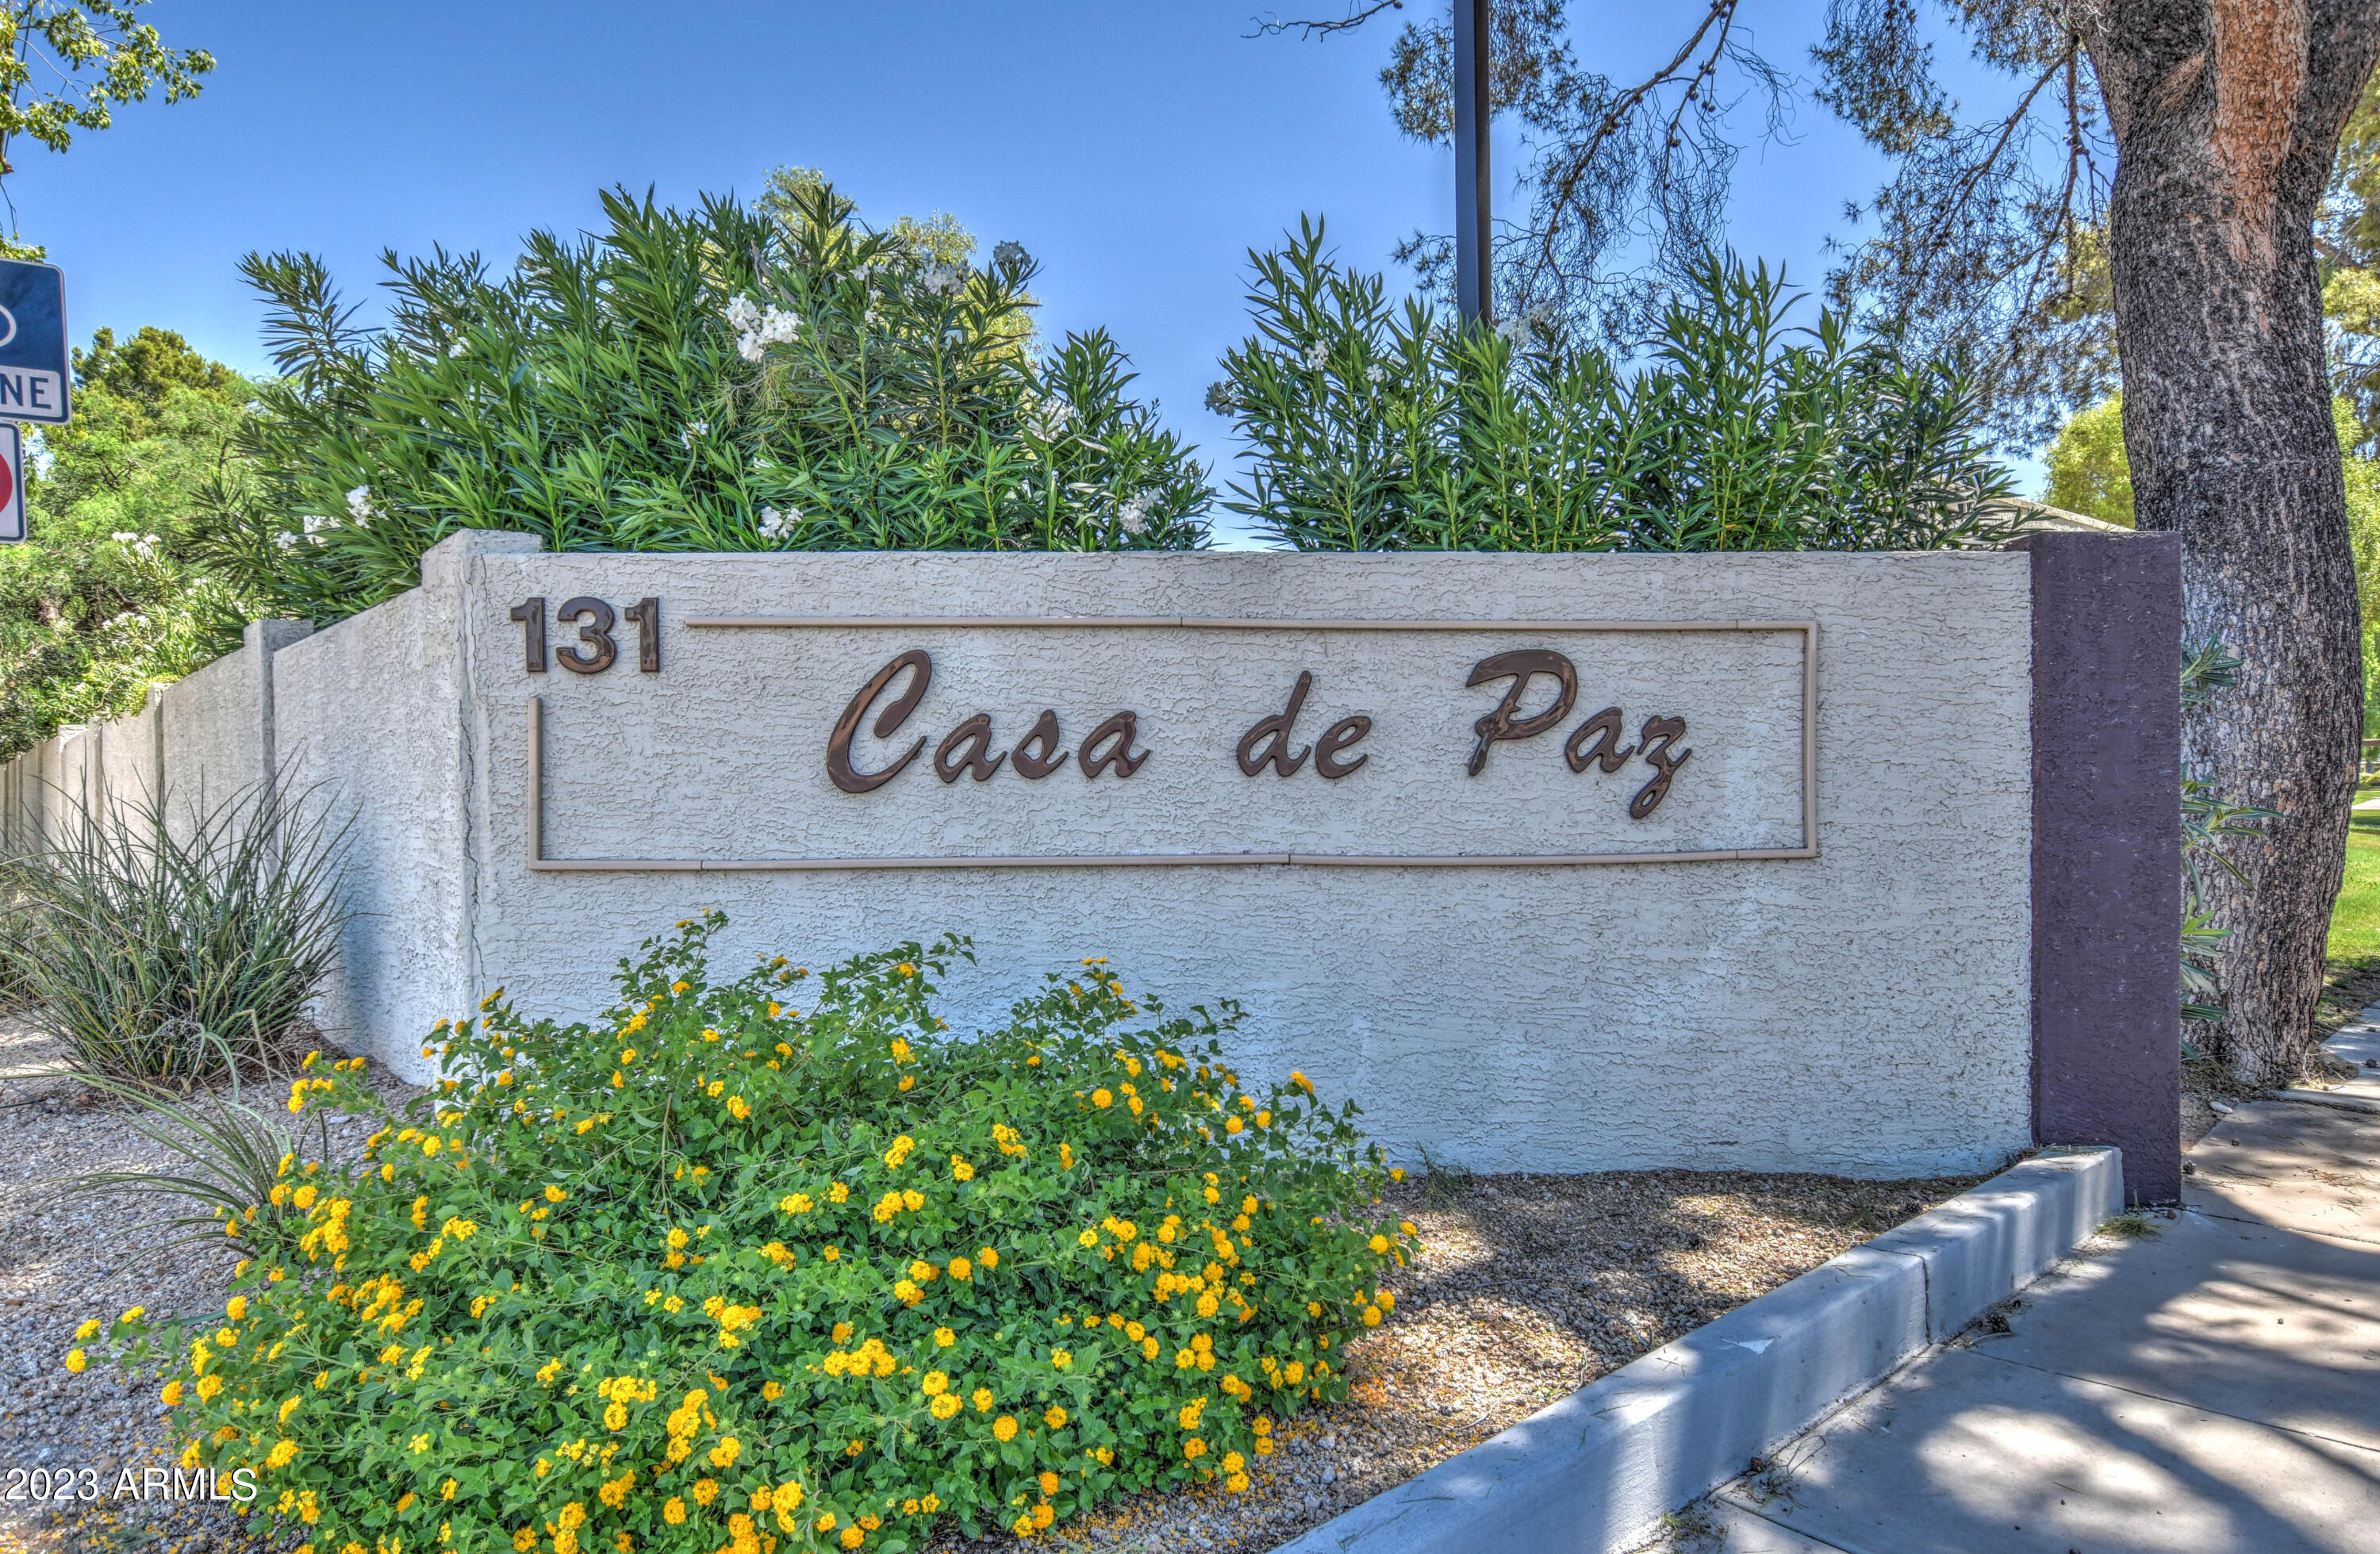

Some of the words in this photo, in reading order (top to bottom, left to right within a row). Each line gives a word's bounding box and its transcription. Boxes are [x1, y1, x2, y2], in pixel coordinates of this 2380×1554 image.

[510, 597, 660, 673] 131
[827, 649, 1150, 793] Casa
[1235, 670, 1372, 778] de
[1466, 649, 1692, 819] Paz
